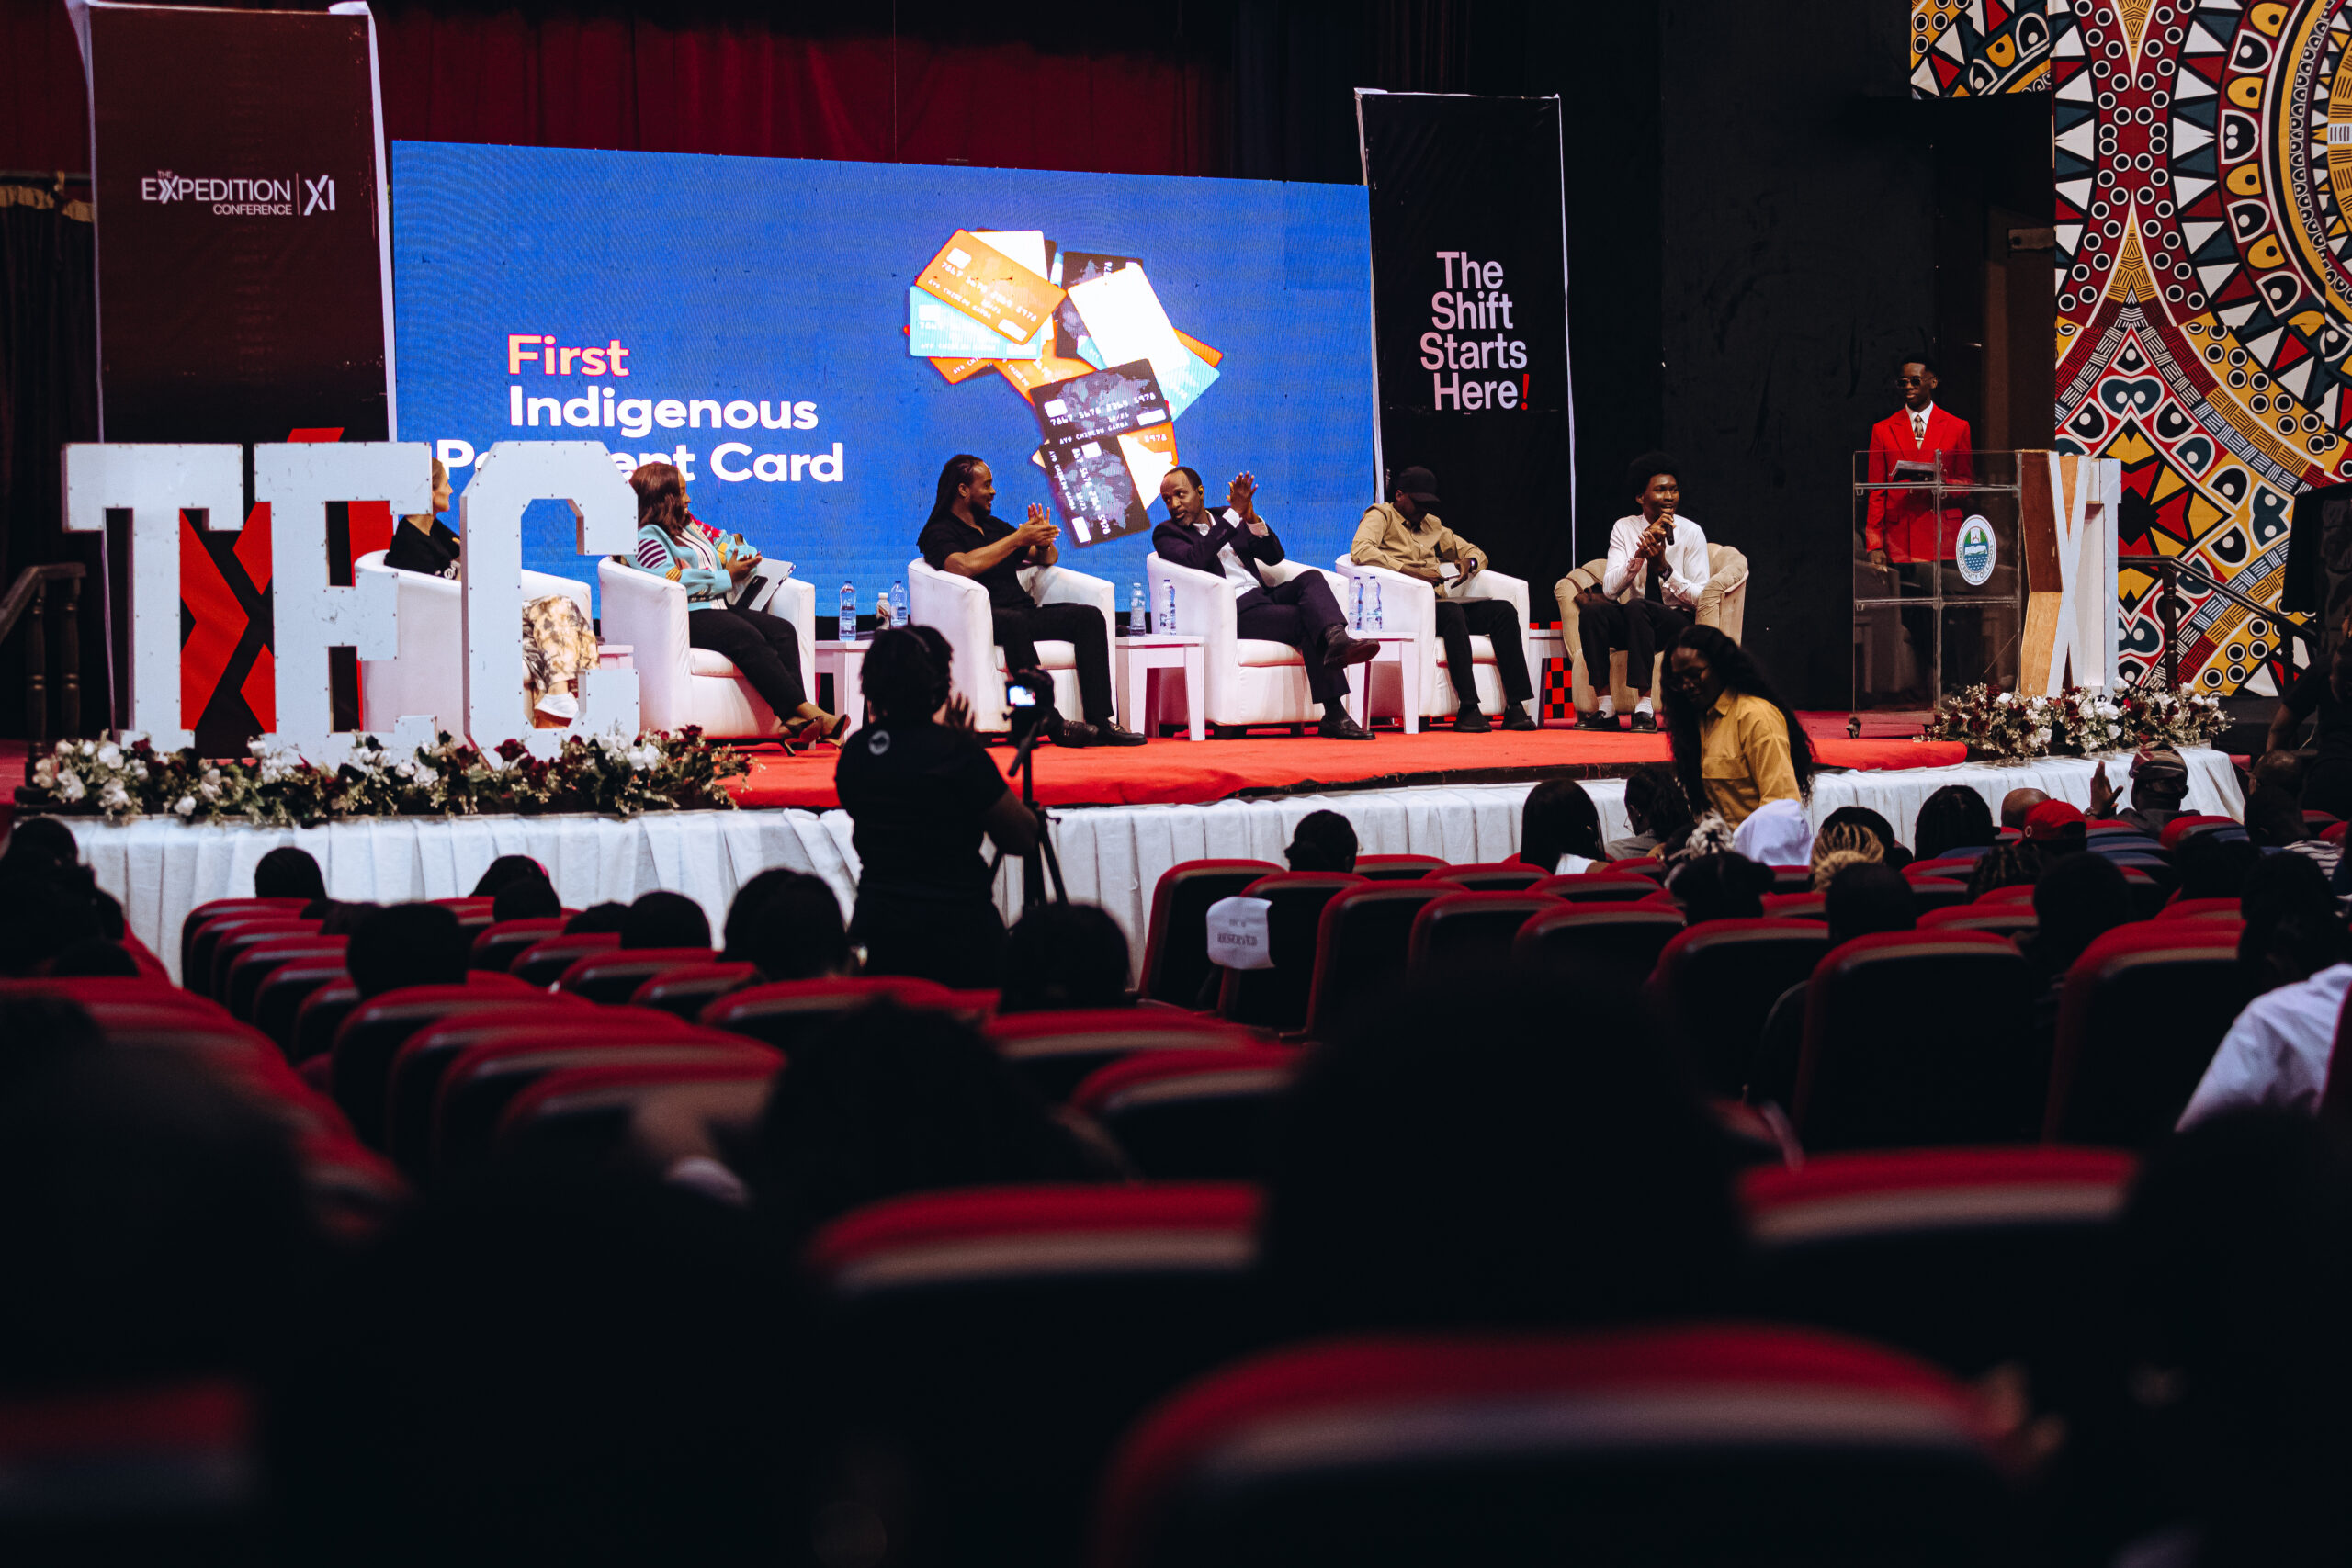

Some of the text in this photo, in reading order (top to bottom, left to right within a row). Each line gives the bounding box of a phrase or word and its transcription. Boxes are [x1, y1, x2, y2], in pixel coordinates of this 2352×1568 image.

[157, 170, 173, 178] THE
[141, 175, 335, 216] EXPEDITION XI
[213, 204, 292, 216] CONFERENCE
[1436, 251, 1504, 289] The
[1431, 290, 1514, 331] Shift
[508, 334, 630, 377] First
[1419, 332, 1528, 370] Starts
[509, 385, 820, 438] Indigenous
[1433, 372, 1530, 411] Here!
[709, 441, 844, 482] Card
[62, 440, 640, 764] TEC
